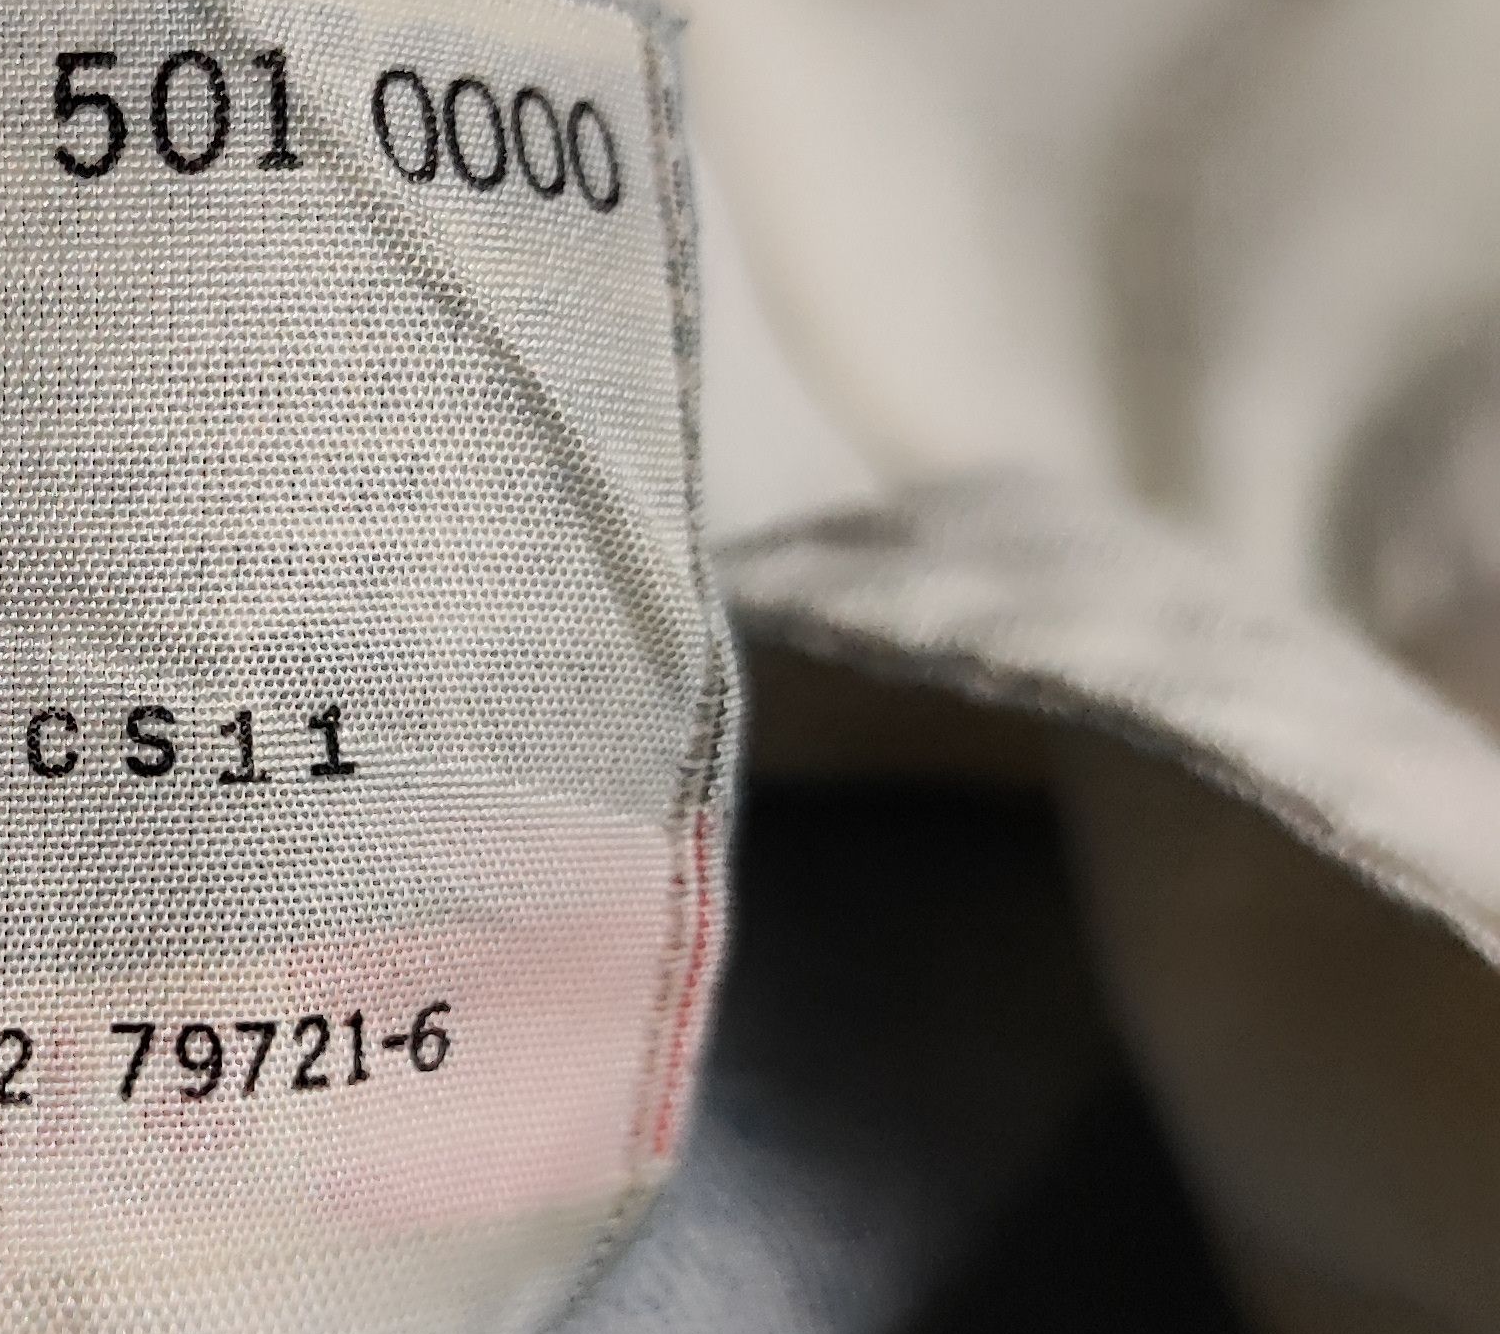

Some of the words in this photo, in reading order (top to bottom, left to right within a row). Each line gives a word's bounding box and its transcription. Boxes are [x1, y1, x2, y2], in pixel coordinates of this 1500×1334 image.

[53, 48, 303, 178] 501
[372, 69, 622, 213] 0000
[111, 1001, 453, 1100] 79721-6
